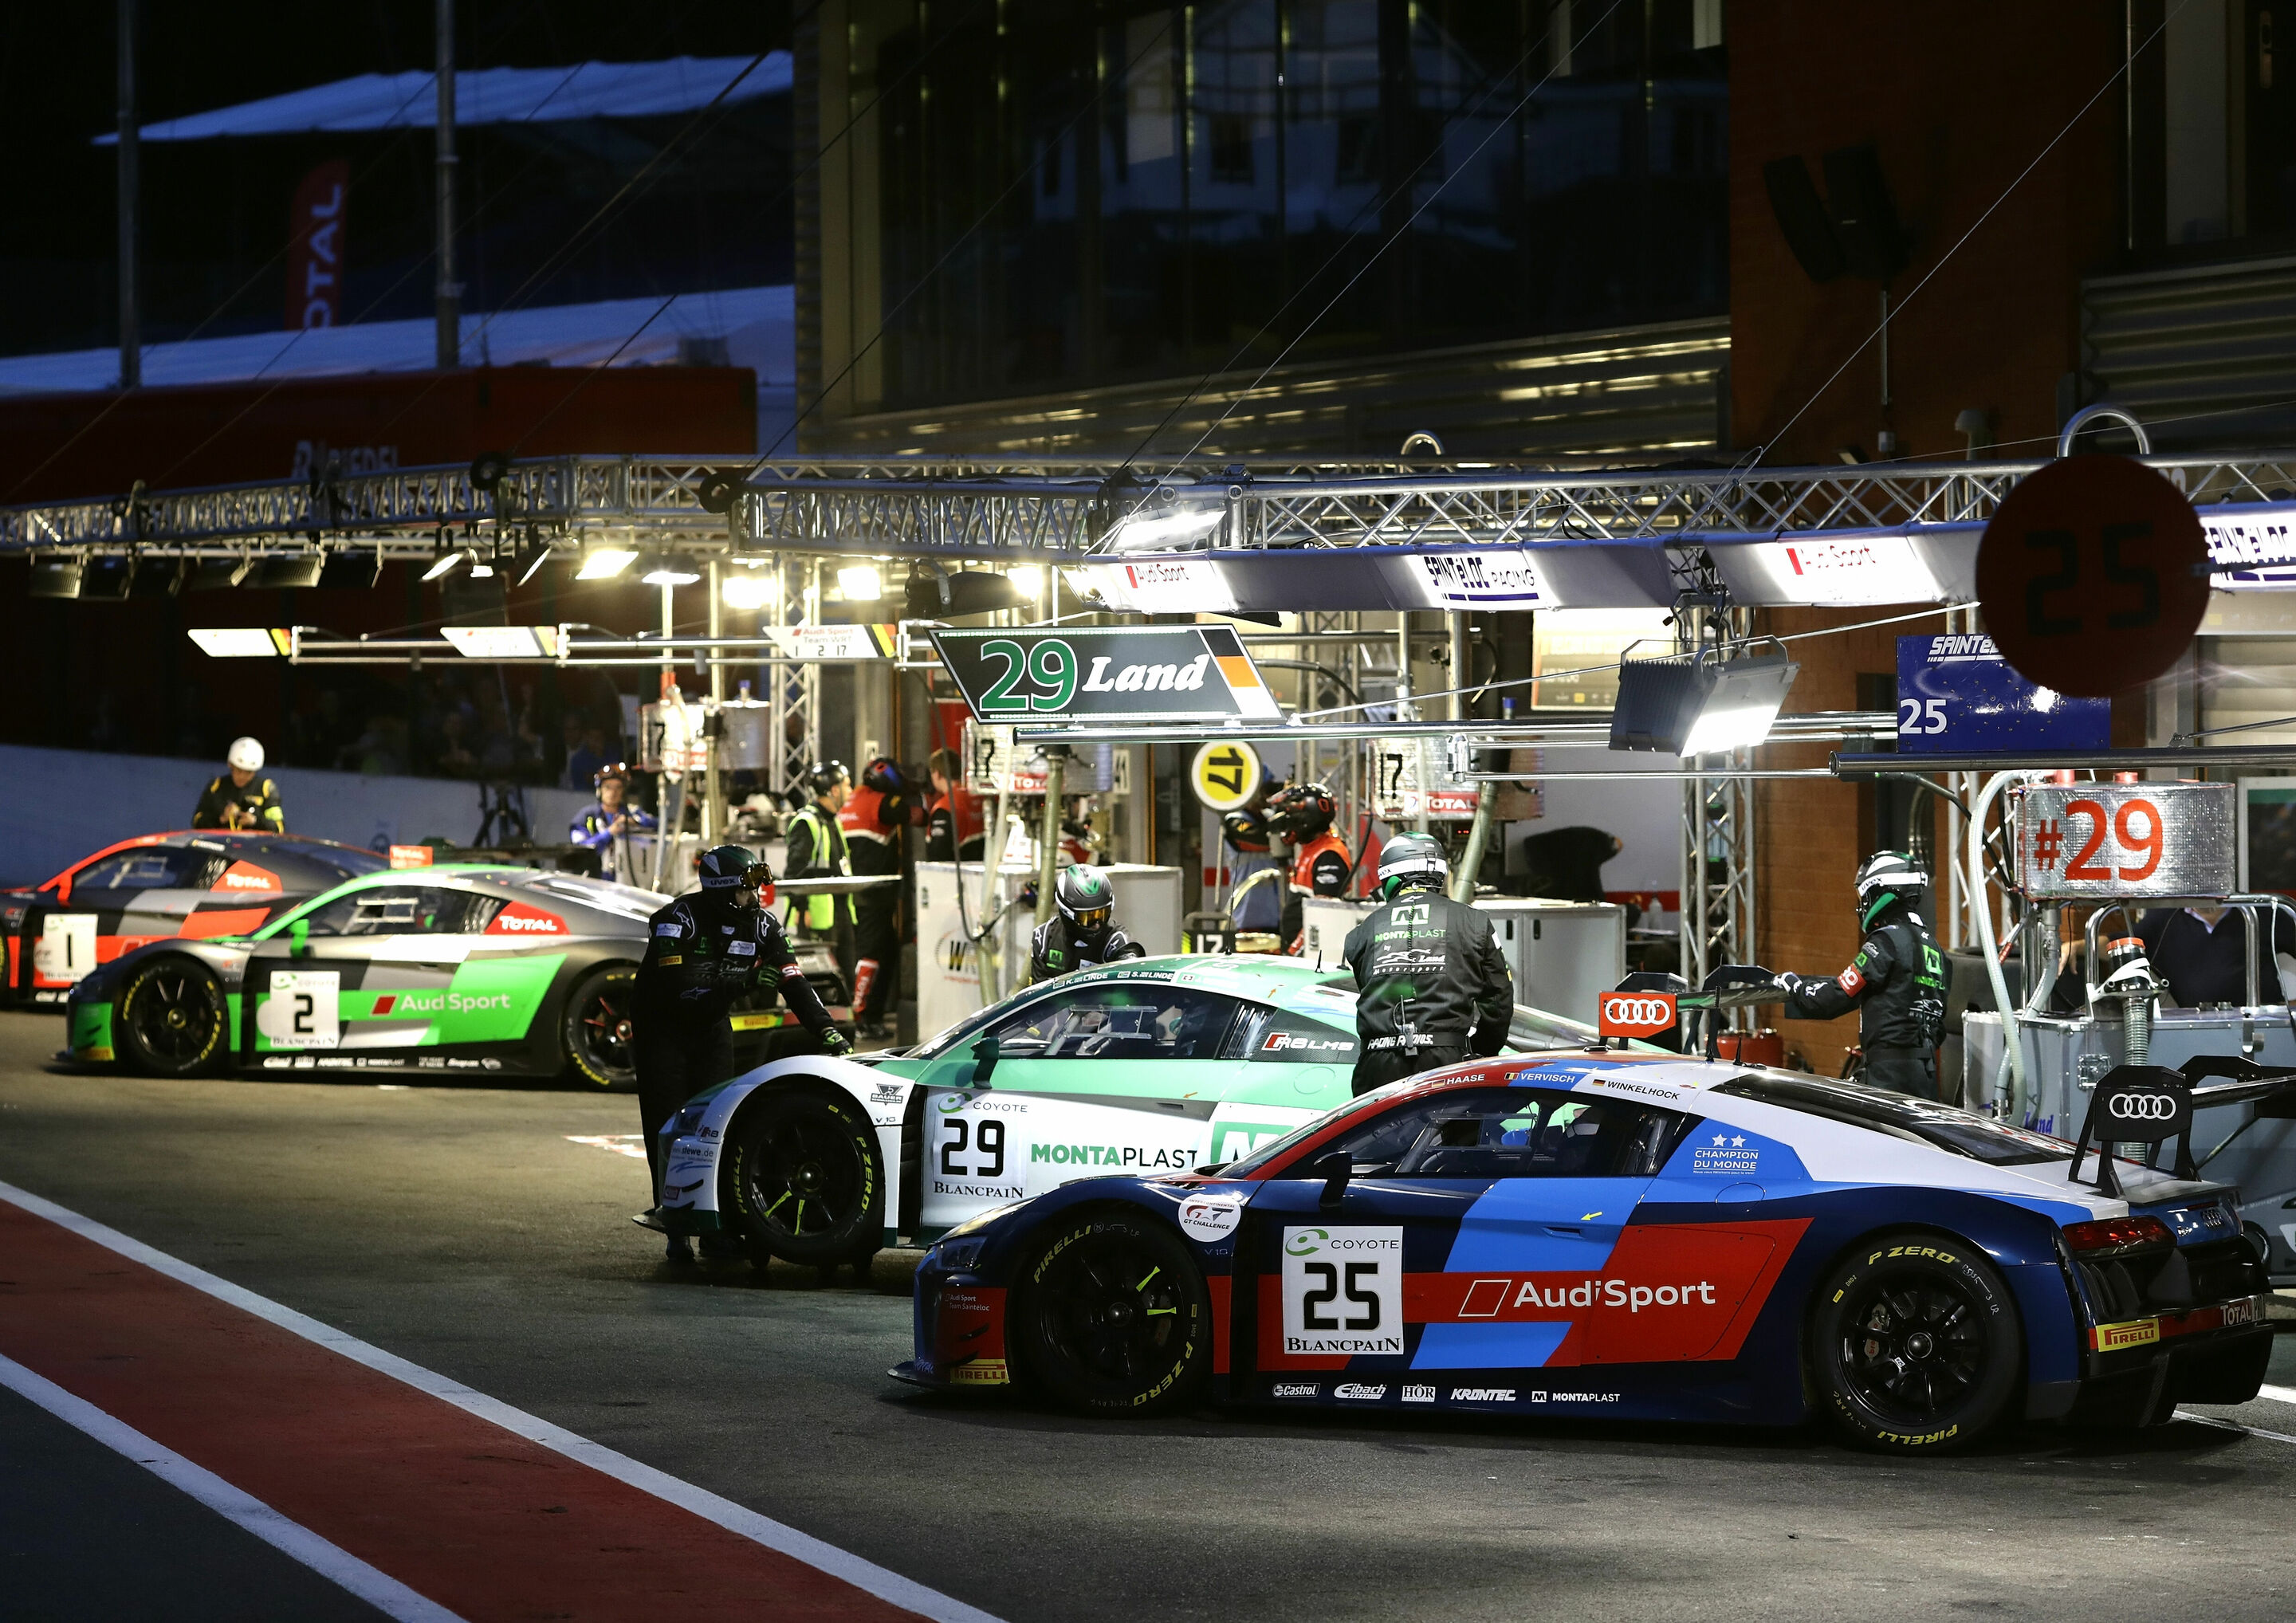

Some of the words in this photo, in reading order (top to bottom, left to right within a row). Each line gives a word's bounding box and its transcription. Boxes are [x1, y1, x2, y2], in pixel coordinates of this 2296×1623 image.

[304, 183, 341, 328] OTAL
[1135, 563, 1157, 584] Audi
[1157, 563, 1189, 584] Sport
[1493, 568, 1535, 588] RACING
[2025, 521, 2161, 636] 25
[818, 645, 824, 657] 2
[979, 638, 1079, 713] 29
[1081, 653, 1211, 693] Land
[1899, 699, 1948, 735] 25
[1208, 747, 1244, 795] 17
[1380, 753, 1403, 800] 17
[224, 873, 271, 890] TOTAL
[710, 877, 736, 886] uvex
[1862, 876, 1883, 892] uvex
[498, 915, 558, 932] TOTAL
[1197, 933, 1223, 954] 17
[1374, 929, 1447, 943] MONTAPLAST
[67, 933, 73, 969] 1
[1083, 973, 1109, 982] LINDE
[448, 993, 511, 1013] Sport
[295, 994, 313, 1032] 2
[1367, 1034, 1396, 1051] RACING
[1446, 1074, 1485, 1085] HAASE
[1521, 1072, 1575, 1084] VERVISCH
[1607, 1081, 1680, 1101] WINKELHOCK
[973, 1102, 1028, 1114] COYOTE
[942, 1118, 1005, 1177] 29
[1031, 1144, 1198, 1169] MONTAPLAST
[1695, 1150, 1759, 1160] CHAMPION
[1713, 1161, 1757, 1169] MONDE
[934, 1181, 1024, 1200] BLANCPAIN
[1193, 1220, 1230, 1230] CHALLENGE
[1034, 1225, 1091, 1283] PIRELLI
[1331, 1240, 1400, 1249] COYOTE
[1887, 1246, 1956, 1264] ZERO
[1303, 1262, 1380, 1330] 25
[1603, 1279, 1716, 1313] Sport
[2219, 1304, 2252, 1326] TOTAL
[2105, 1322, 2156, 1346] PIRELLI
[1287, 1338, 1401, 1352] BLANCPAIN
[1134, 1360, 1184, 1406] ZERO
[1284, 1384, 1316, 1396] Castrol
[1335, 1383, 1386, 1395] Eibach
[1403, 1383, 1435, 1398] HÖR
[1450, 1388, 1516, 1401] KRONTEC
[1552, 1393, 1620, 1403] MONTAPLAST
[1877, 1424, 1958, 1444] PIRELLI
